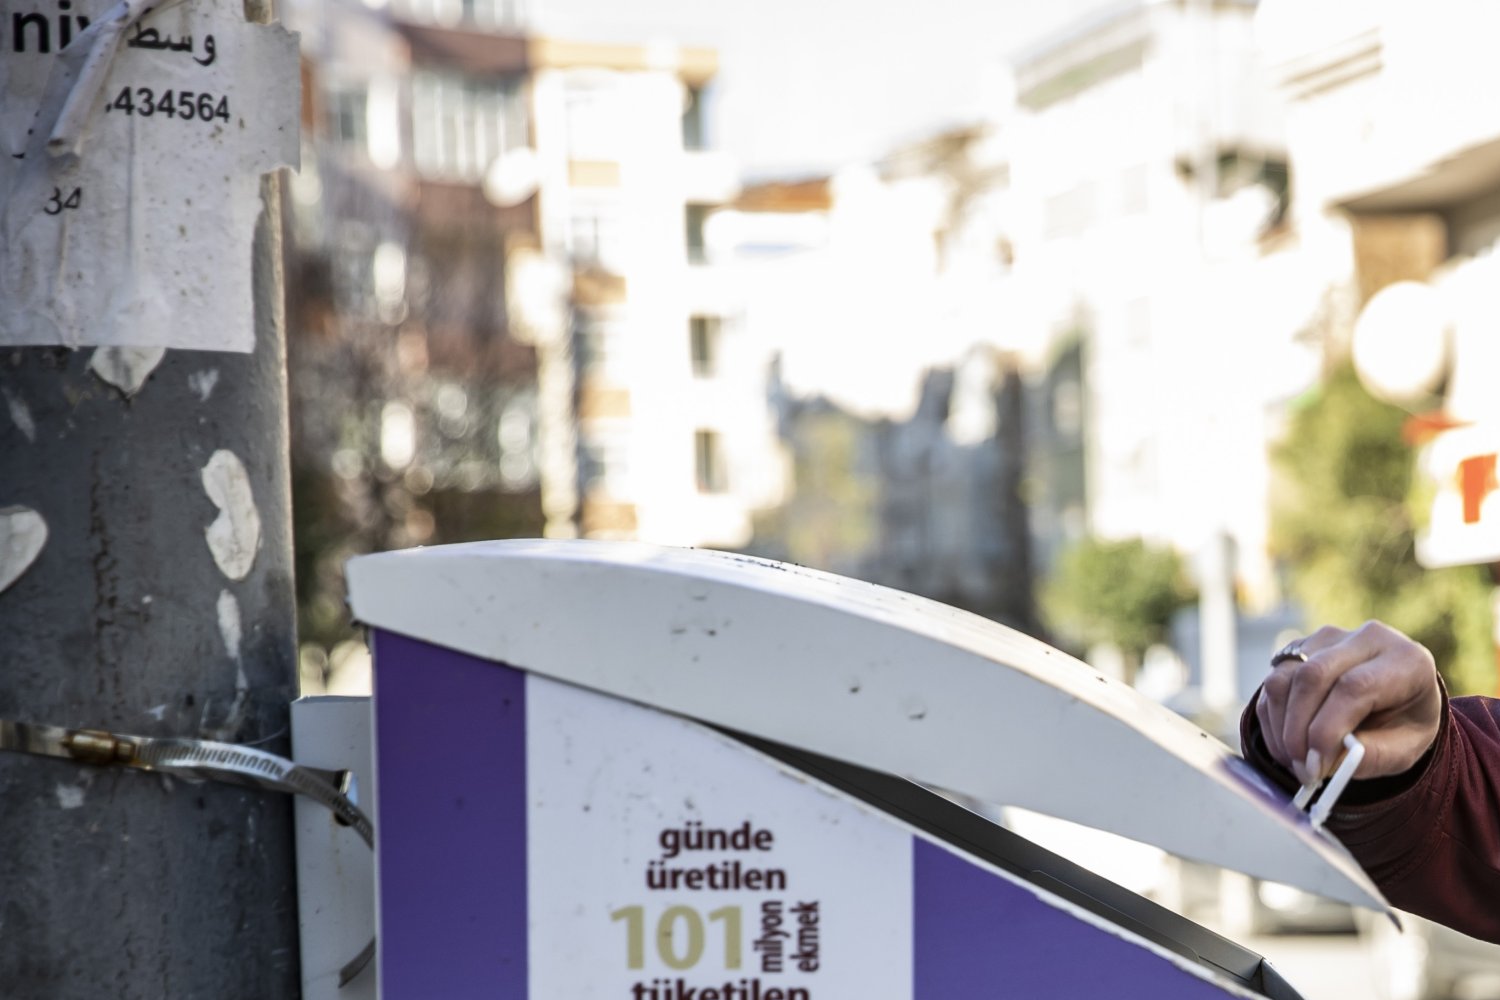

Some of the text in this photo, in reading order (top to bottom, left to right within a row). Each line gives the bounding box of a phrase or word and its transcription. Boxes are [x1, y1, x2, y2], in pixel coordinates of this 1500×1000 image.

[659, 820, 774, 859] günde
[646, 860, 787, 891] üretilen
[610, 904, 743, 971] 101
[753, 900, 790, 973] milyon
[790, 901, 820, 973] ekmek
